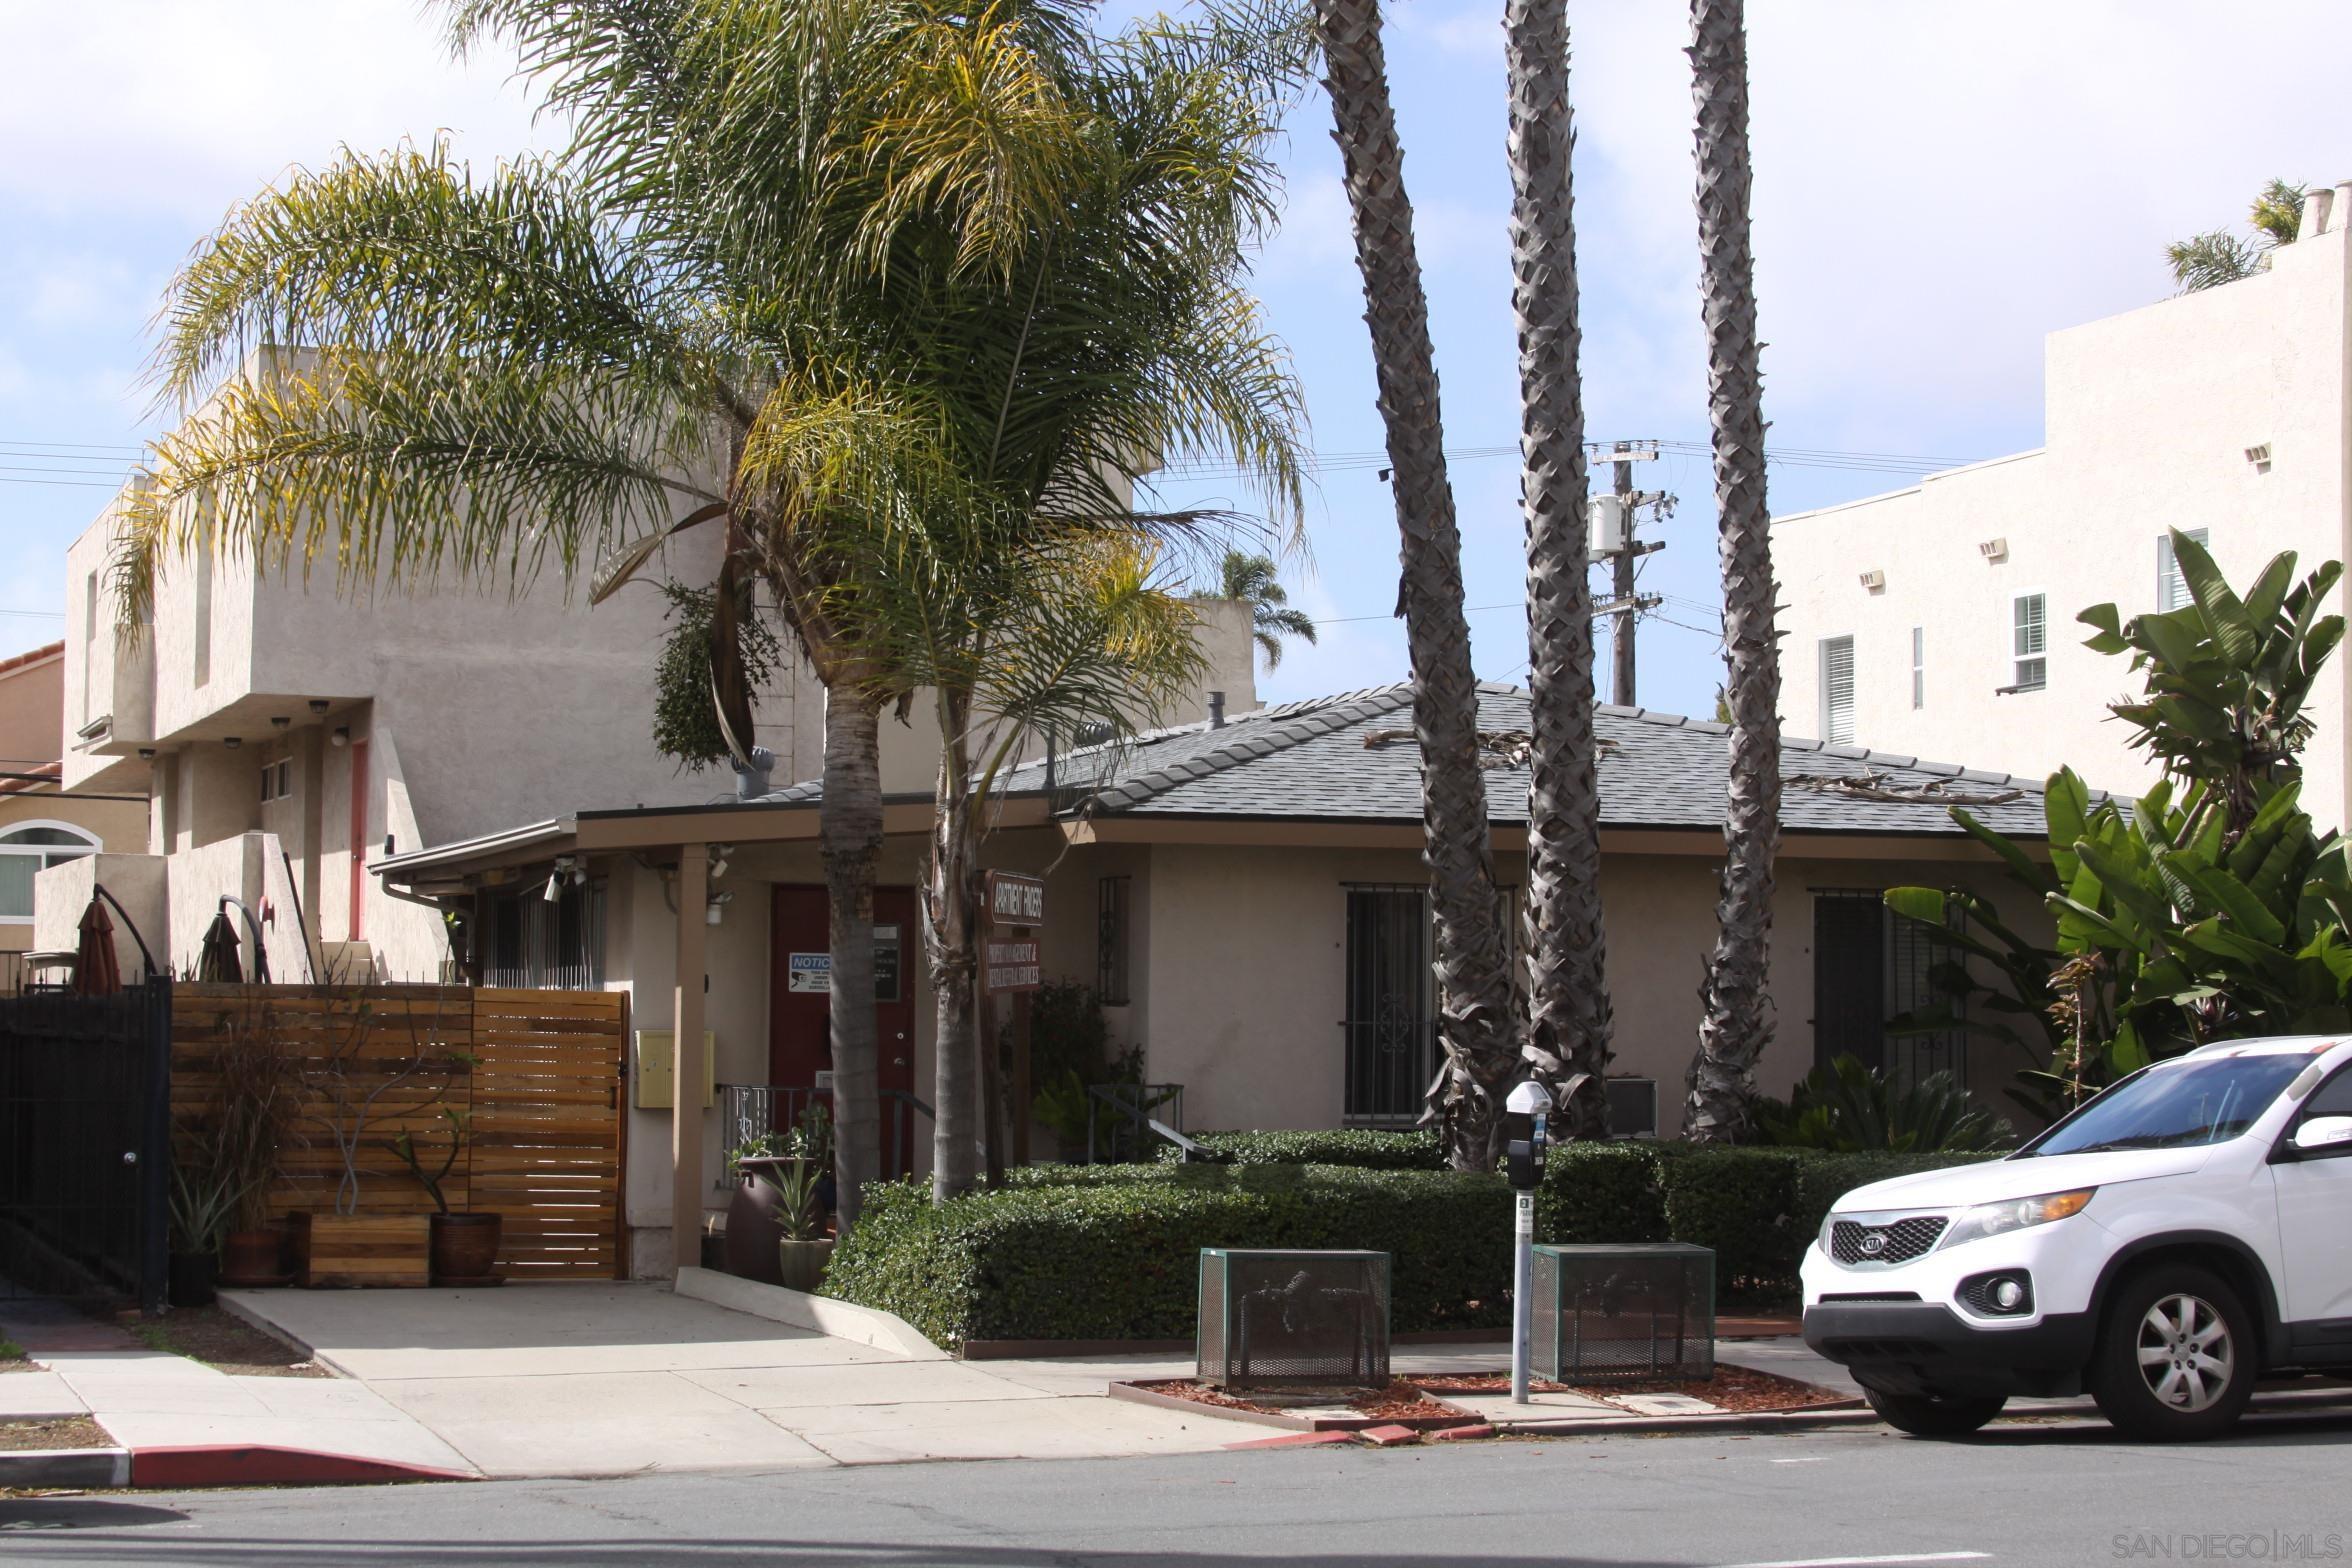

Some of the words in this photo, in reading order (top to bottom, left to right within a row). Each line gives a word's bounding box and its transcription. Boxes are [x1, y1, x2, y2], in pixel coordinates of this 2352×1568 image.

[994, 881, 1023, 915] APARTMENT
[1023, 885, 1042, 918] FINDERS
[793, 957, 830, 968] NOTIC
[1865, 1239, 1880, 1250] KIA
